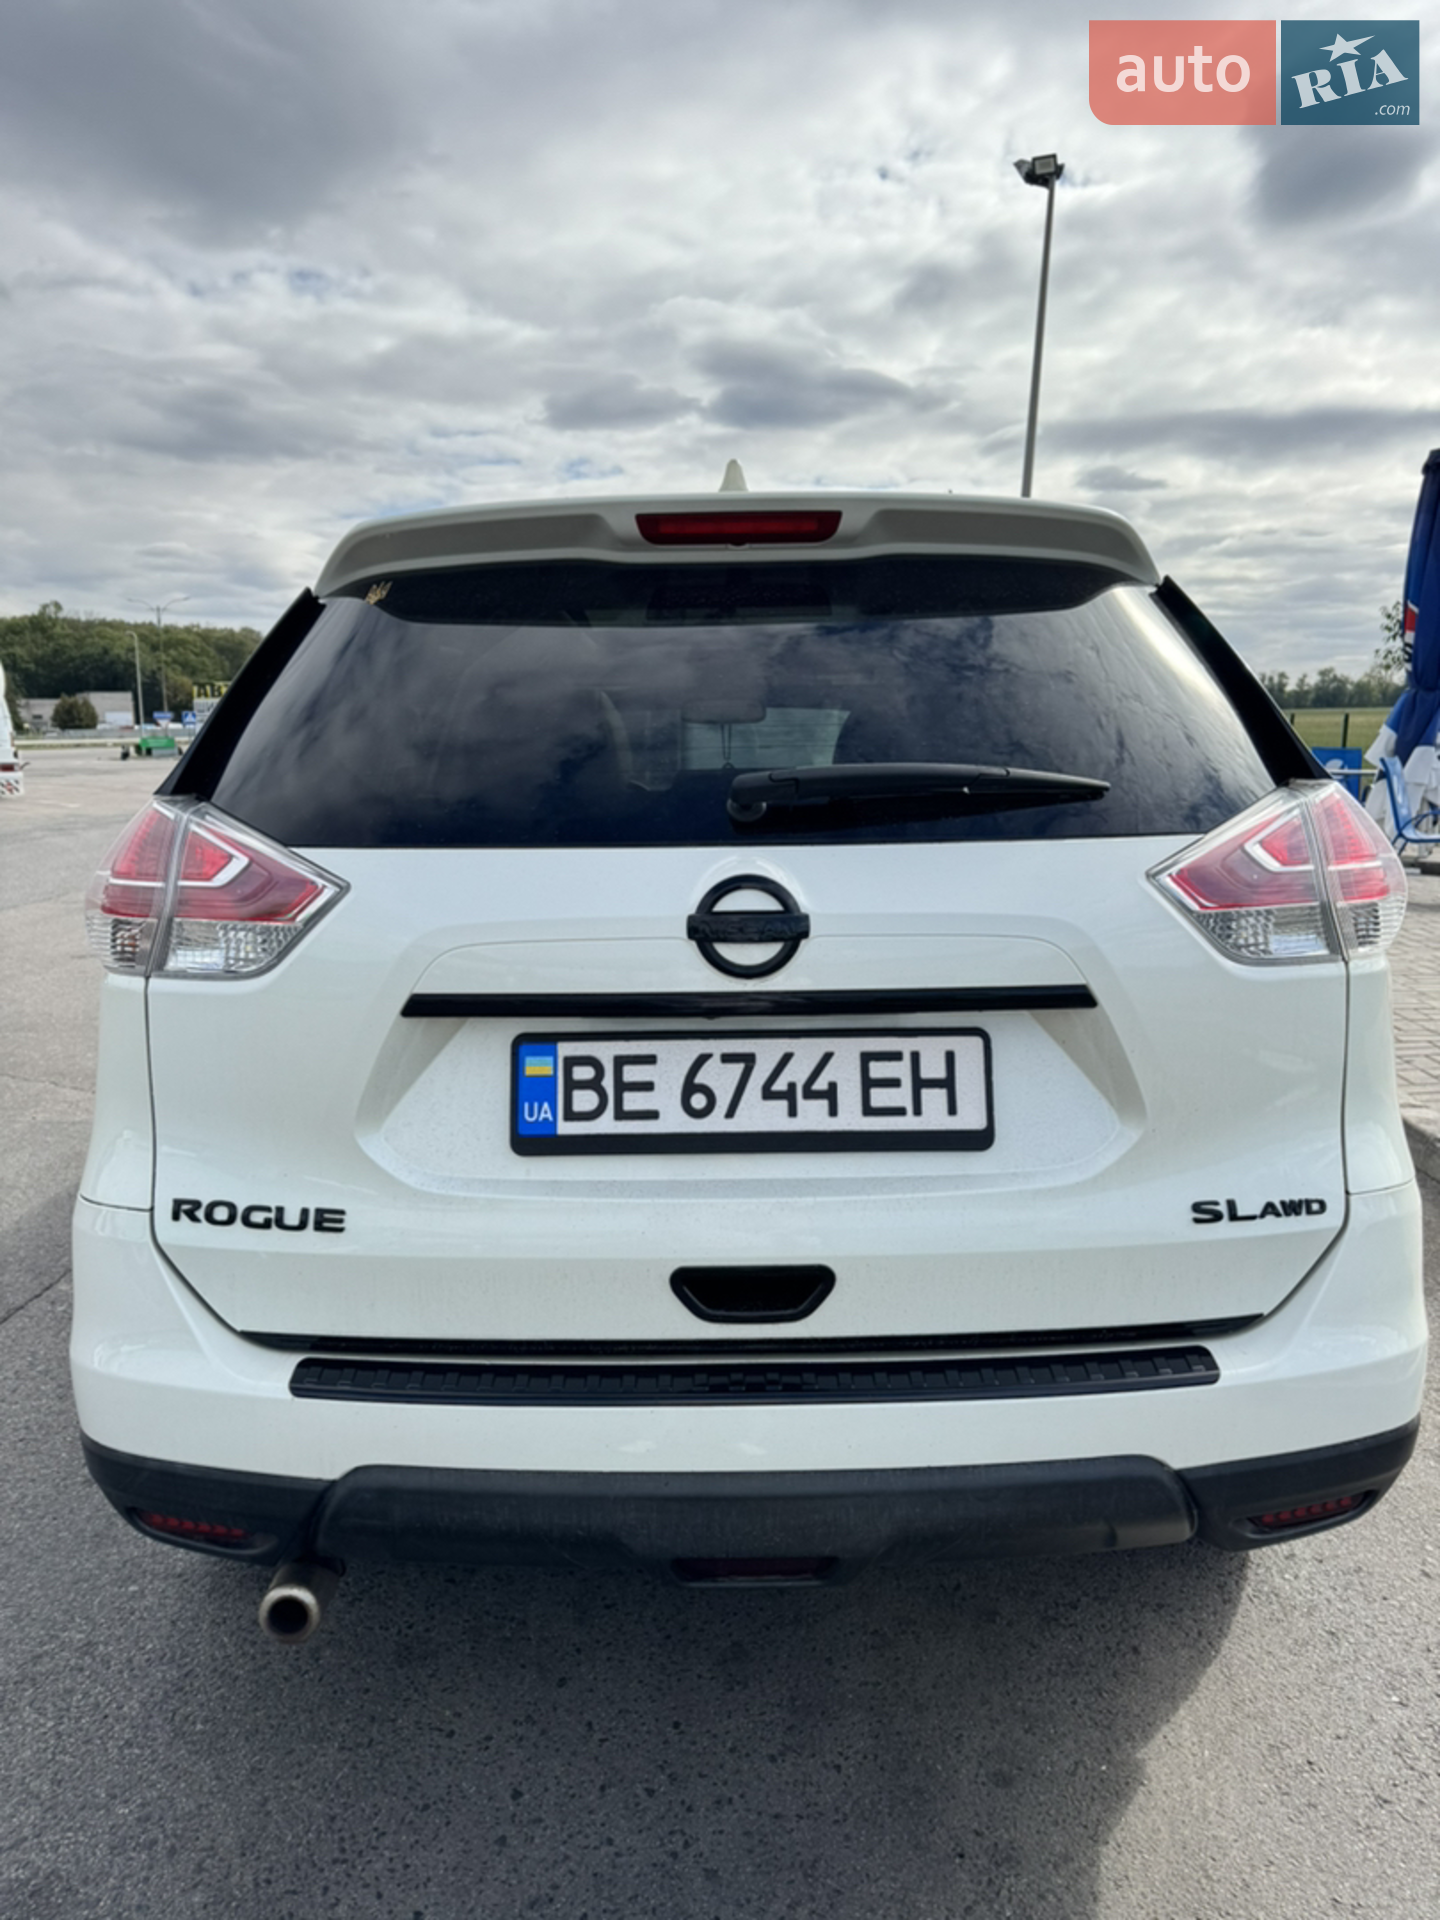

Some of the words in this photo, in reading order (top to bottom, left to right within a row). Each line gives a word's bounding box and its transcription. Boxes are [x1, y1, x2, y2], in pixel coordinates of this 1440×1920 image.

[562, 1053, 660, 1122] BE
[680, 1050, 839, 1120] 6744
[859, 1049, 958, 1118] EH
[523, 1101, 554, 1123] UA
[171, 1197, 347, 1233] ROGUE
